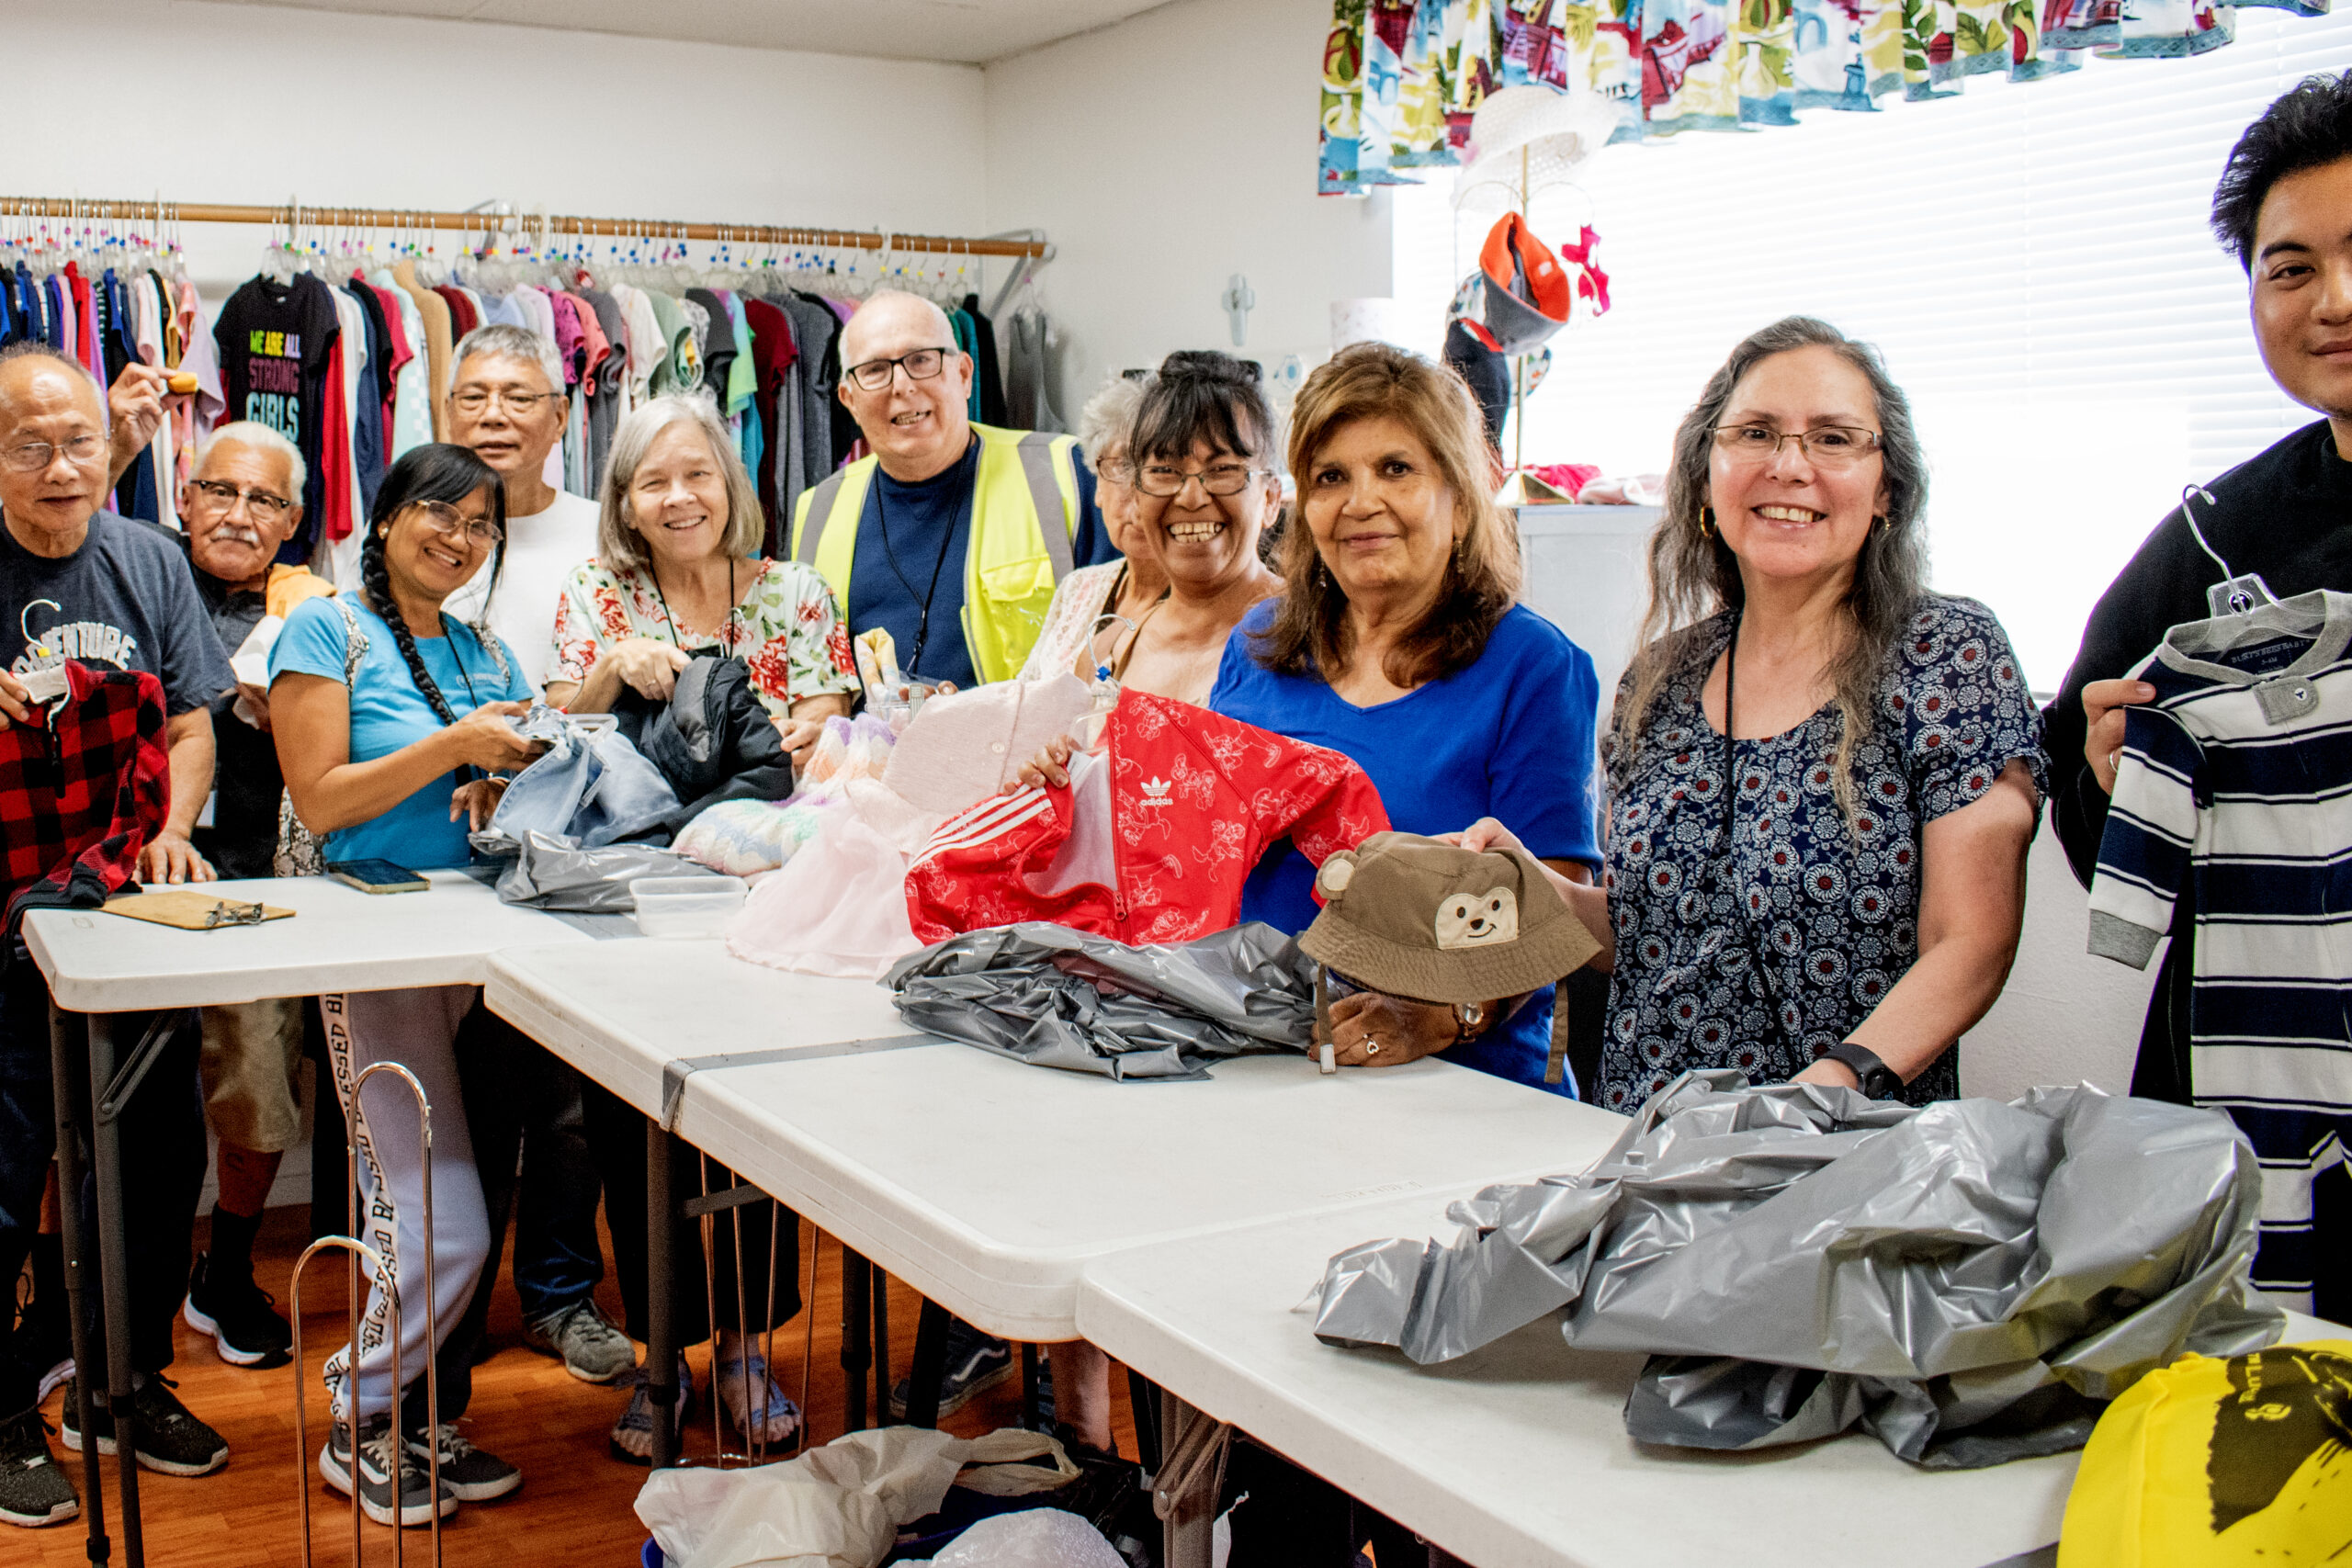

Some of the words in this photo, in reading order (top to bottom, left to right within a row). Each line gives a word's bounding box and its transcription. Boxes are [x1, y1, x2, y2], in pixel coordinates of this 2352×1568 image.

[249, 330, 265, 355] WE
[265, 331, 284, 356] ARE
[284, 333, 301, 358] ALL
[248, 356, 300, 394] STRONG
[245, 391, 300, 444] GIRLS
[1140, 797, 1173, 806] adidas
